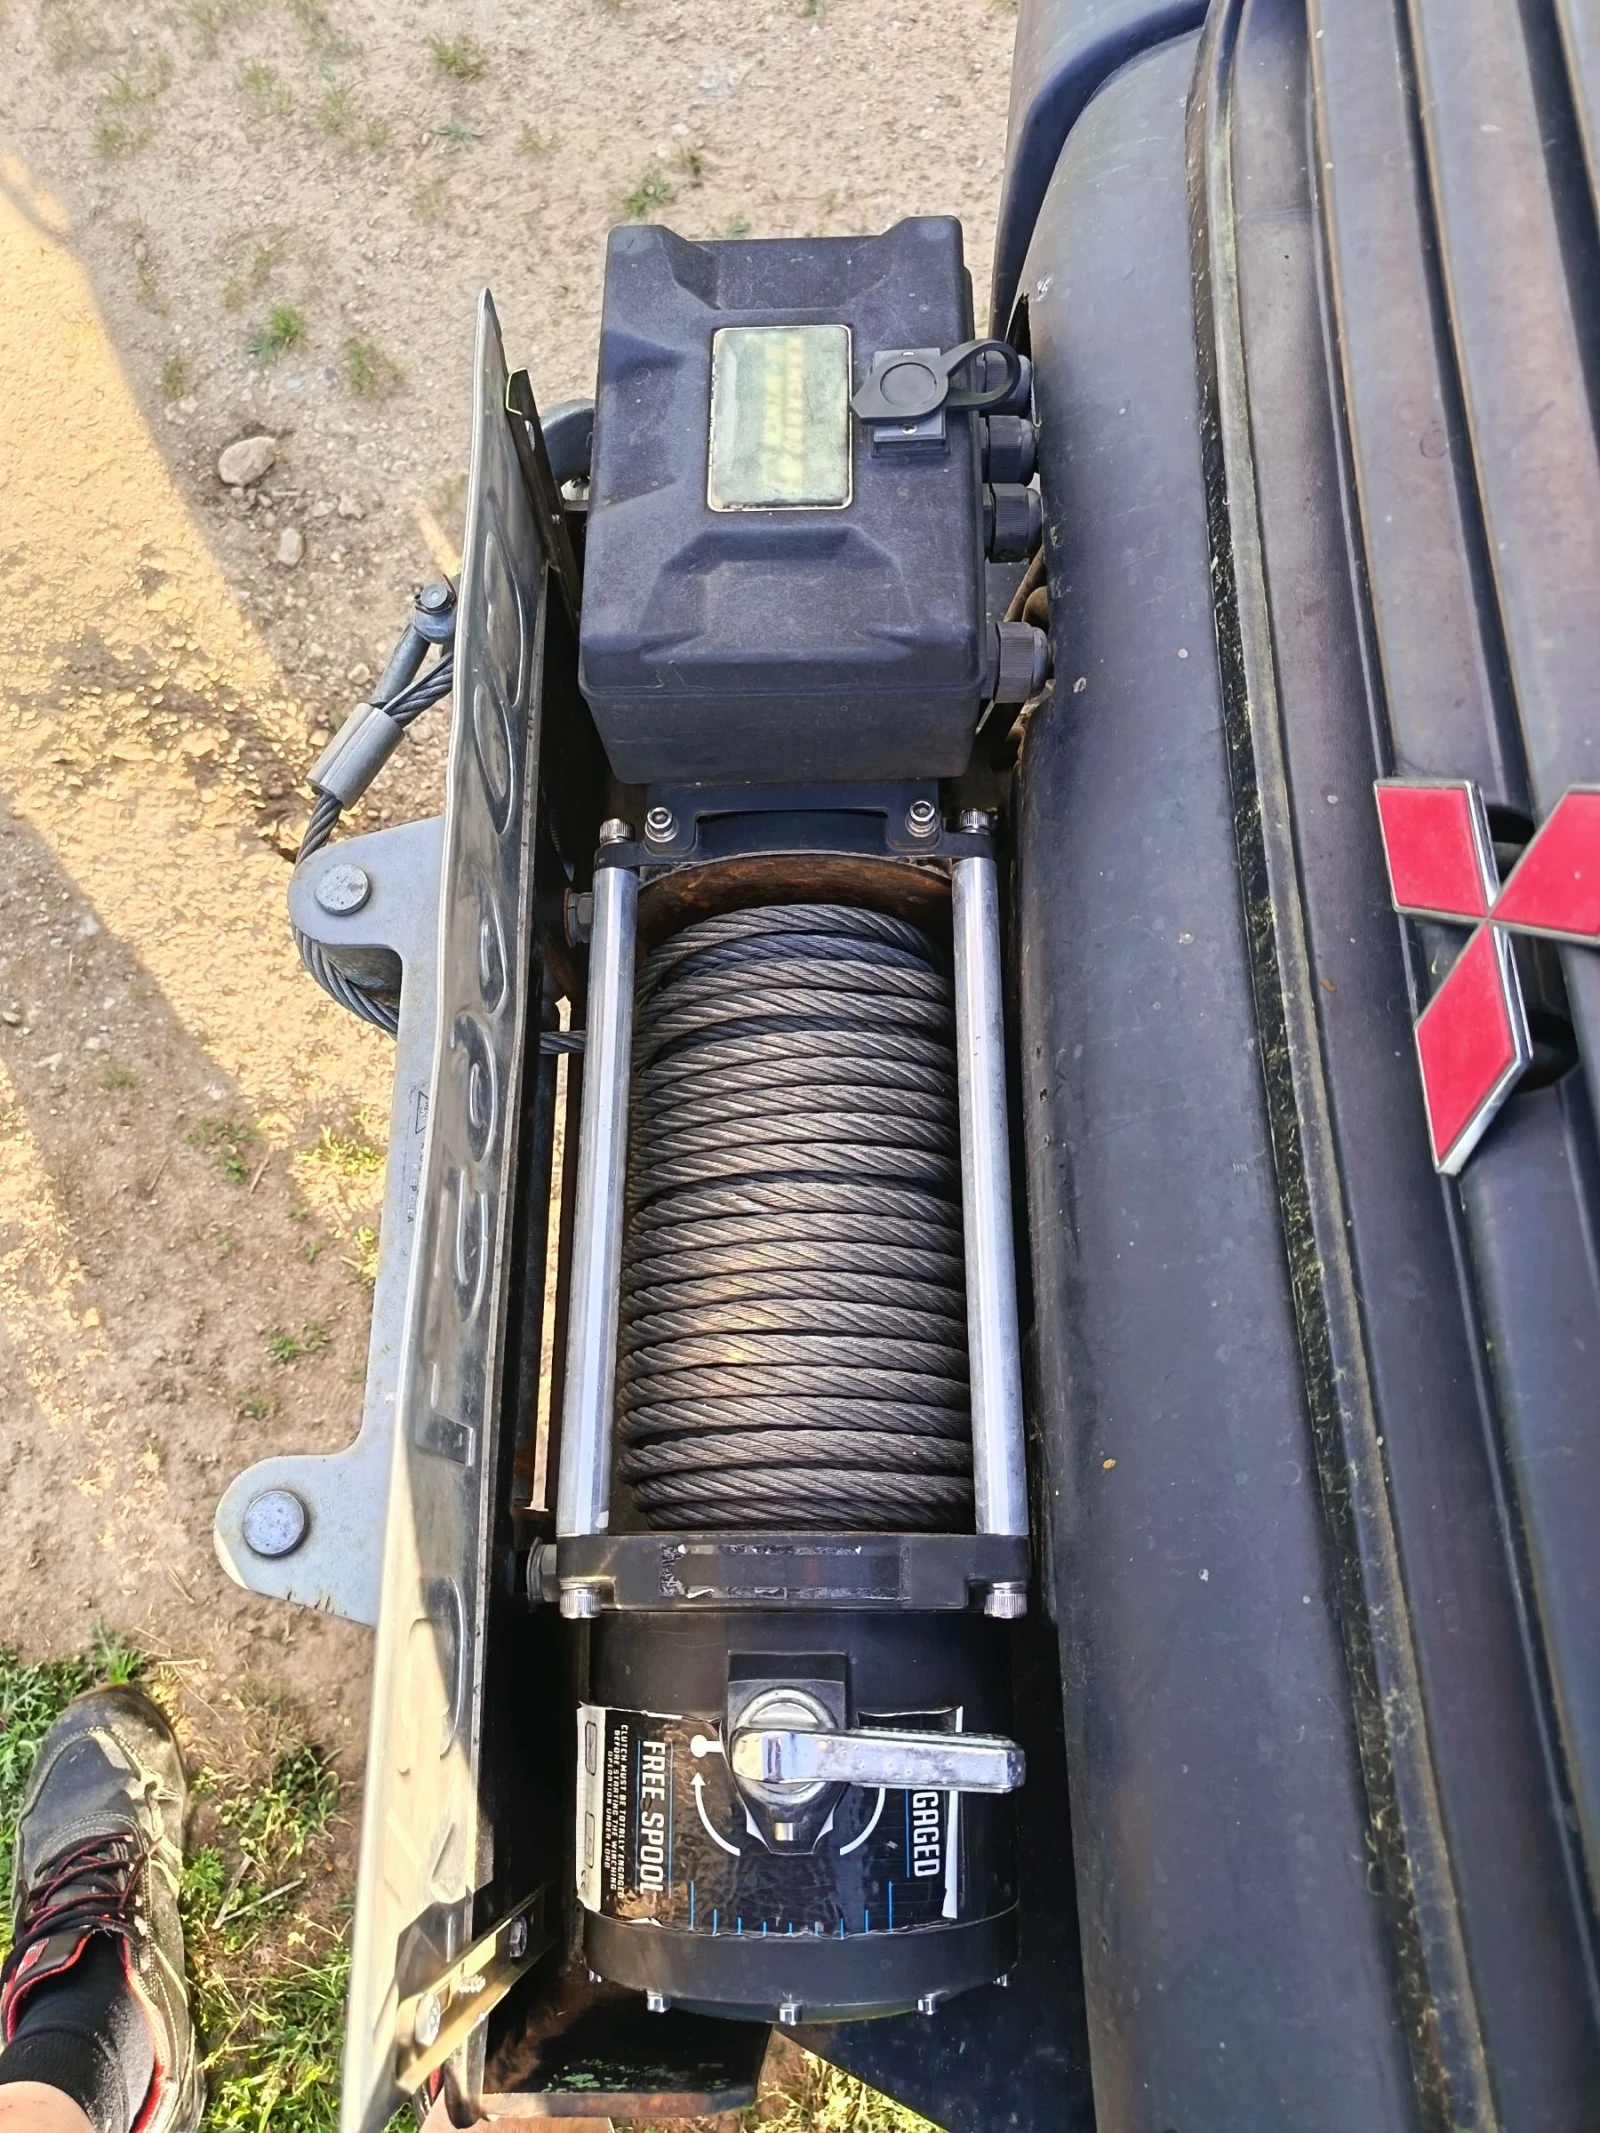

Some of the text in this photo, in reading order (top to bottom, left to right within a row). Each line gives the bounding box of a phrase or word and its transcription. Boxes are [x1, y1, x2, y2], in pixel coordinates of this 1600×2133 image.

[613, 1730, 621, 1766] BEFORE
[606, 1751, 614, 1804] OPERATION
[612, 1769, 620, 1816] STARTING
[611, 1820, 619, 1837] THE
[617, 1724, 629, 1899] CLUTCH MUST BE TOTALLY ENGAGED
[640, 1741, 666, 1895] FREE SPOOL
[912, 1790, 940, 1877] GAGED
